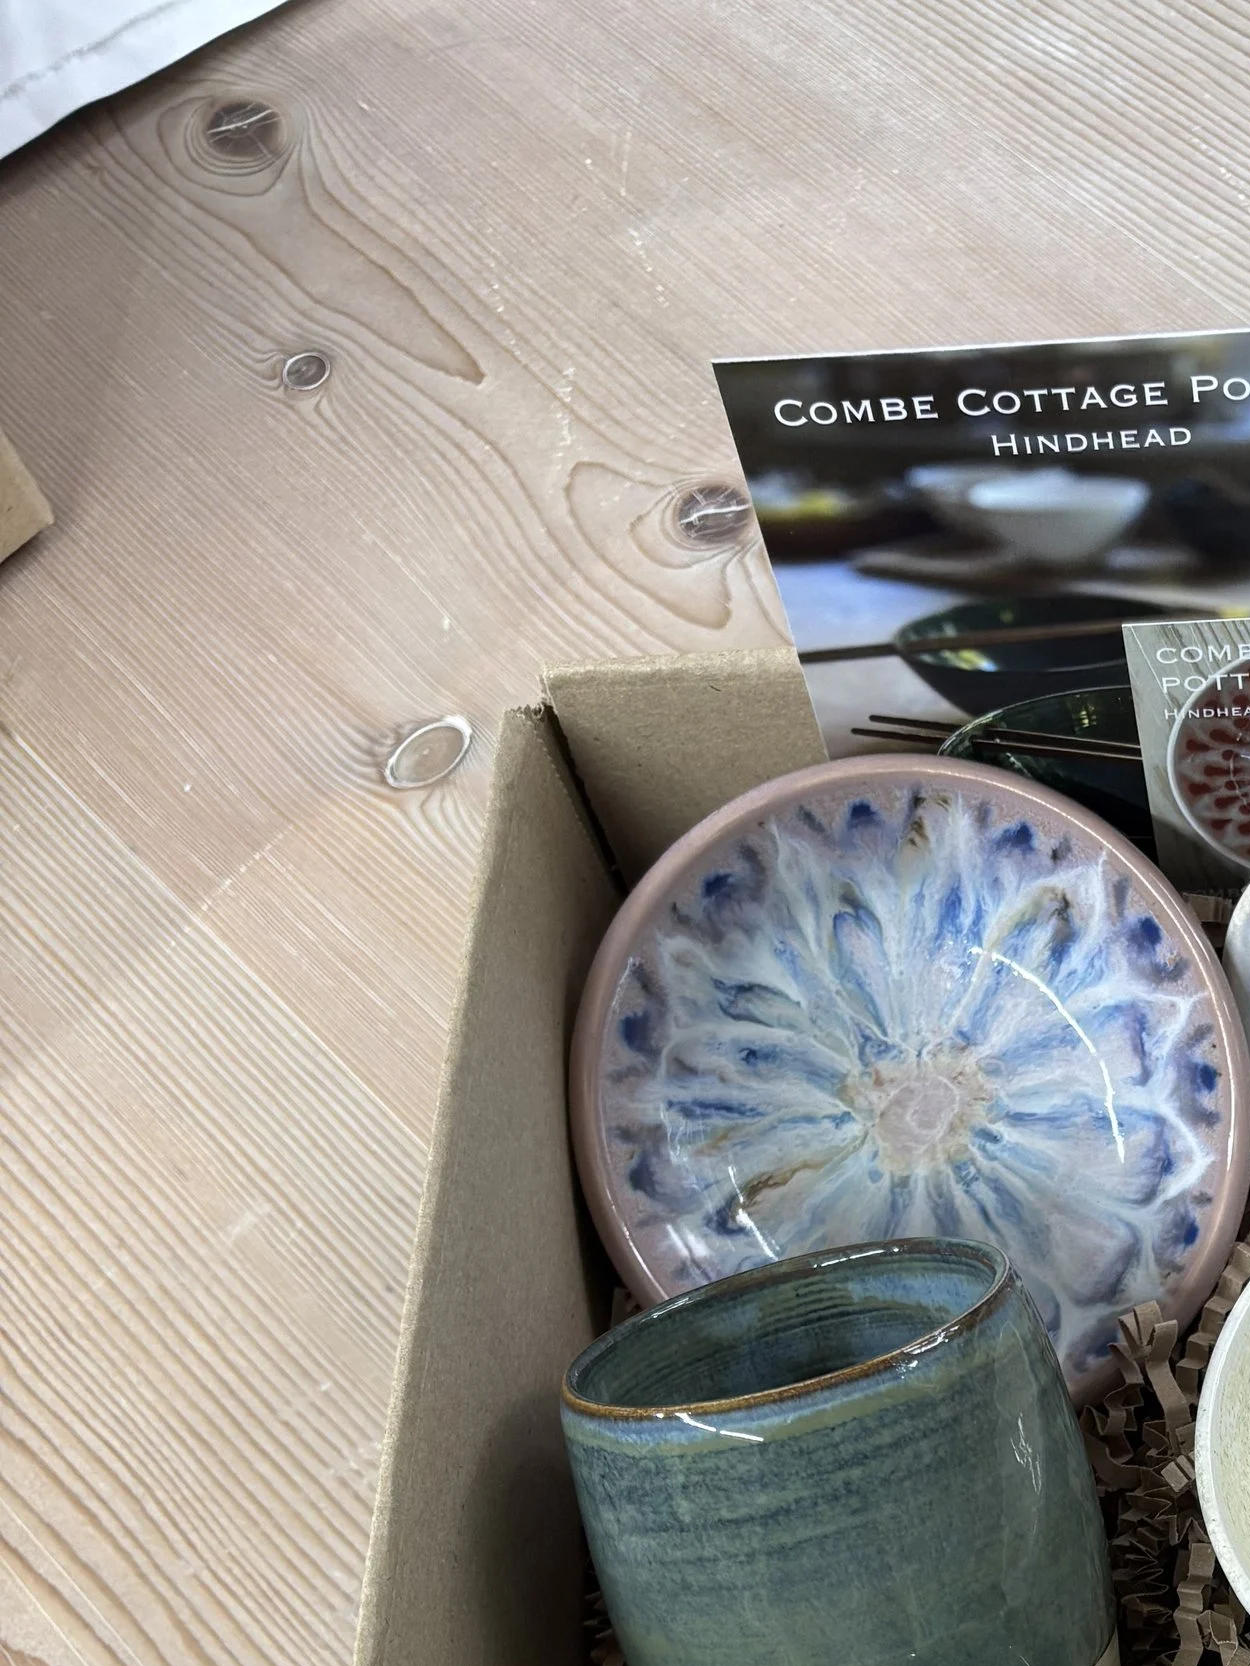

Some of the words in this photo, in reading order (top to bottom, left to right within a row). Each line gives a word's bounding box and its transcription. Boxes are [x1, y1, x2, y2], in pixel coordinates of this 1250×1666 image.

[774, 395, 939, 427] COMBE
[957, 381, 1169, 417] COTTAGE
[991, 427, 1192, 456] HINDHEAD
